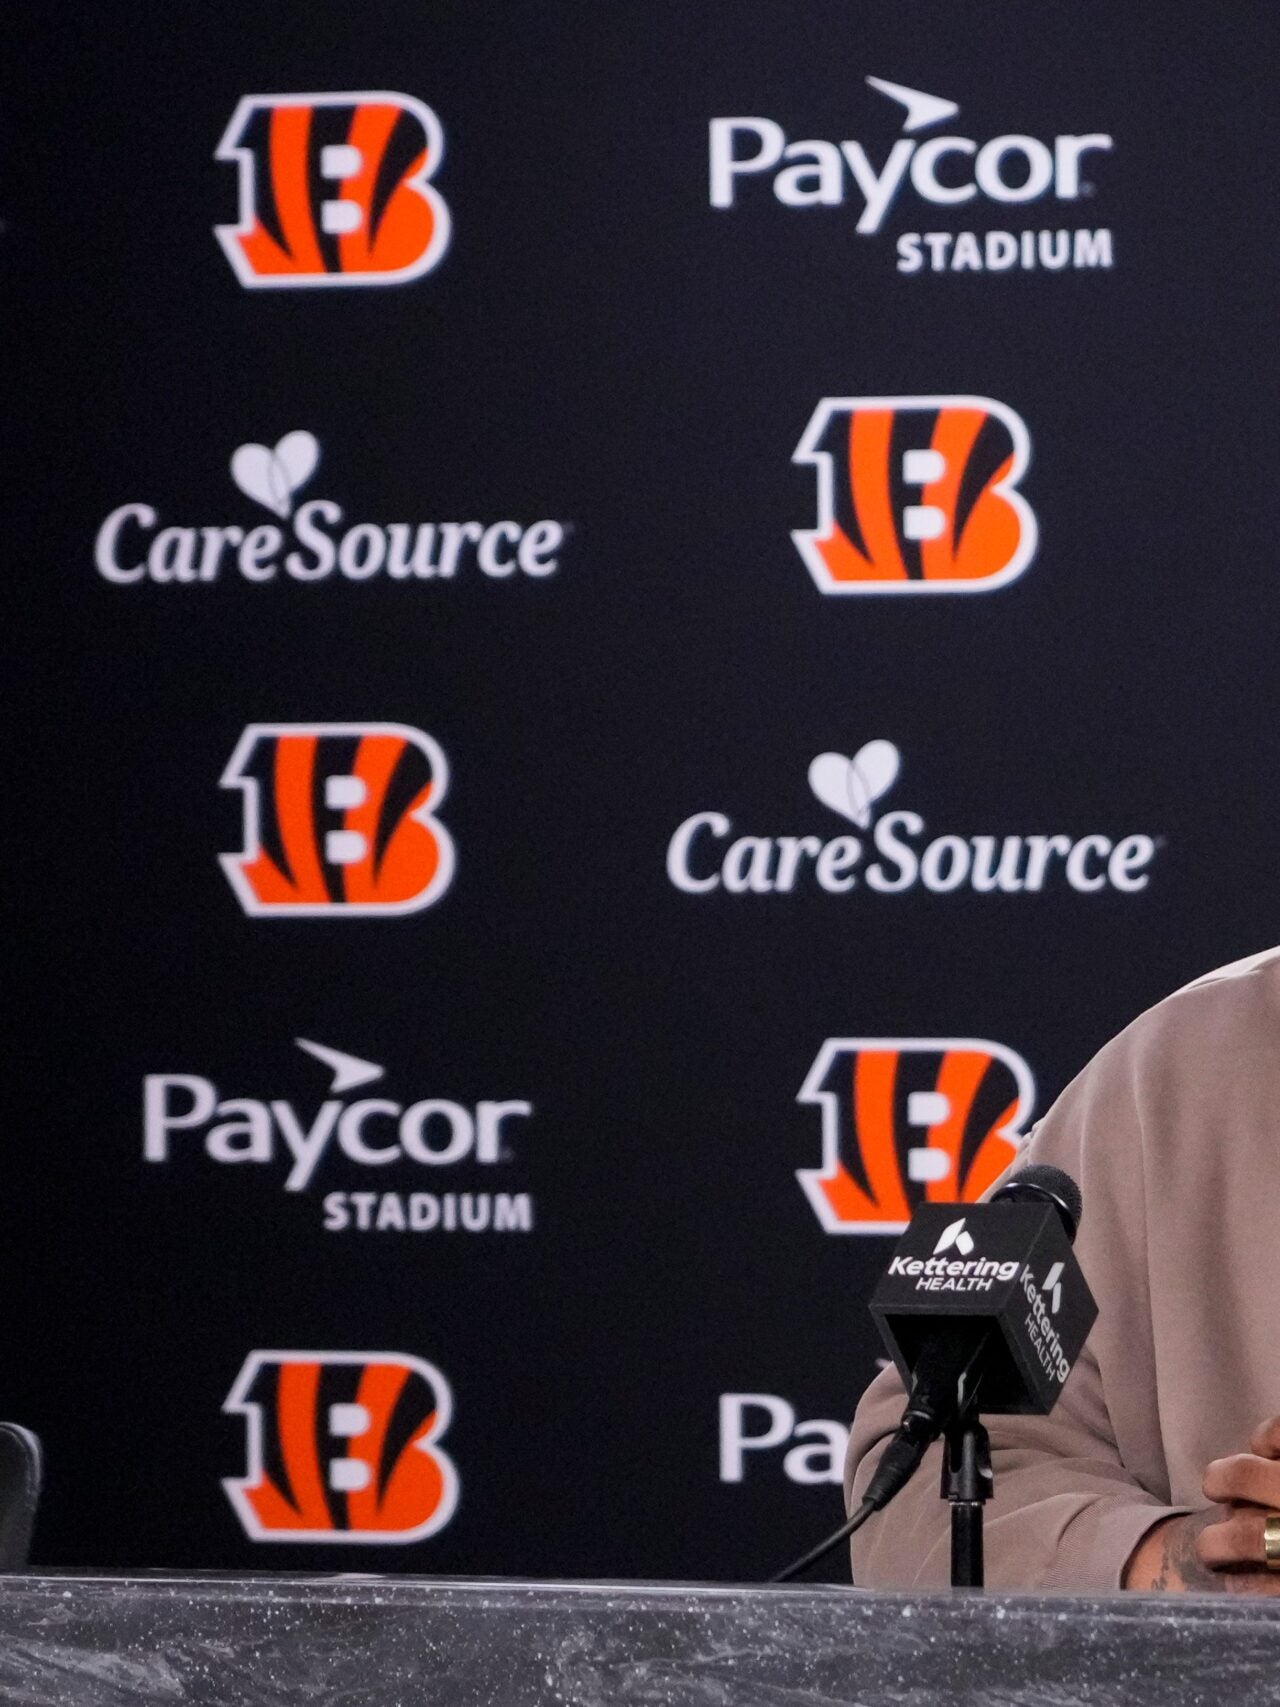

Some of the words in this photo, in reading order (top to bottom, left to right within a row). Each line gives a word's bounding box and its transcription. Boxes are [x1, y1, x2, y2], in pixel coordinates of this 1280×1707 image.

[215, 90, 451, 289] B
[708, 116, 1112, 236] Paycor
[896, 228, 1114, 273] STADIUM
[95, 499, 563, 584] CareSource
[791, 394, 1038, 596] B
[219, 721, 455, 917] B
[666, 810, 1154, 894] CareSource
[144, 1074, 532, 1193] Paycor
[796, 1037, 1034, 1236] B
[324, 1192, 532, 1232] STADIUM
[888, 1256, 1019, 1281] Kettering
[915, 1277, 993, 1291] HEALTH
[1020, 1264, 1070, 1383] Kettering
[1024, 1313, 1055, 1381] HEALTH
[222, 1350, 460, 1544] B
